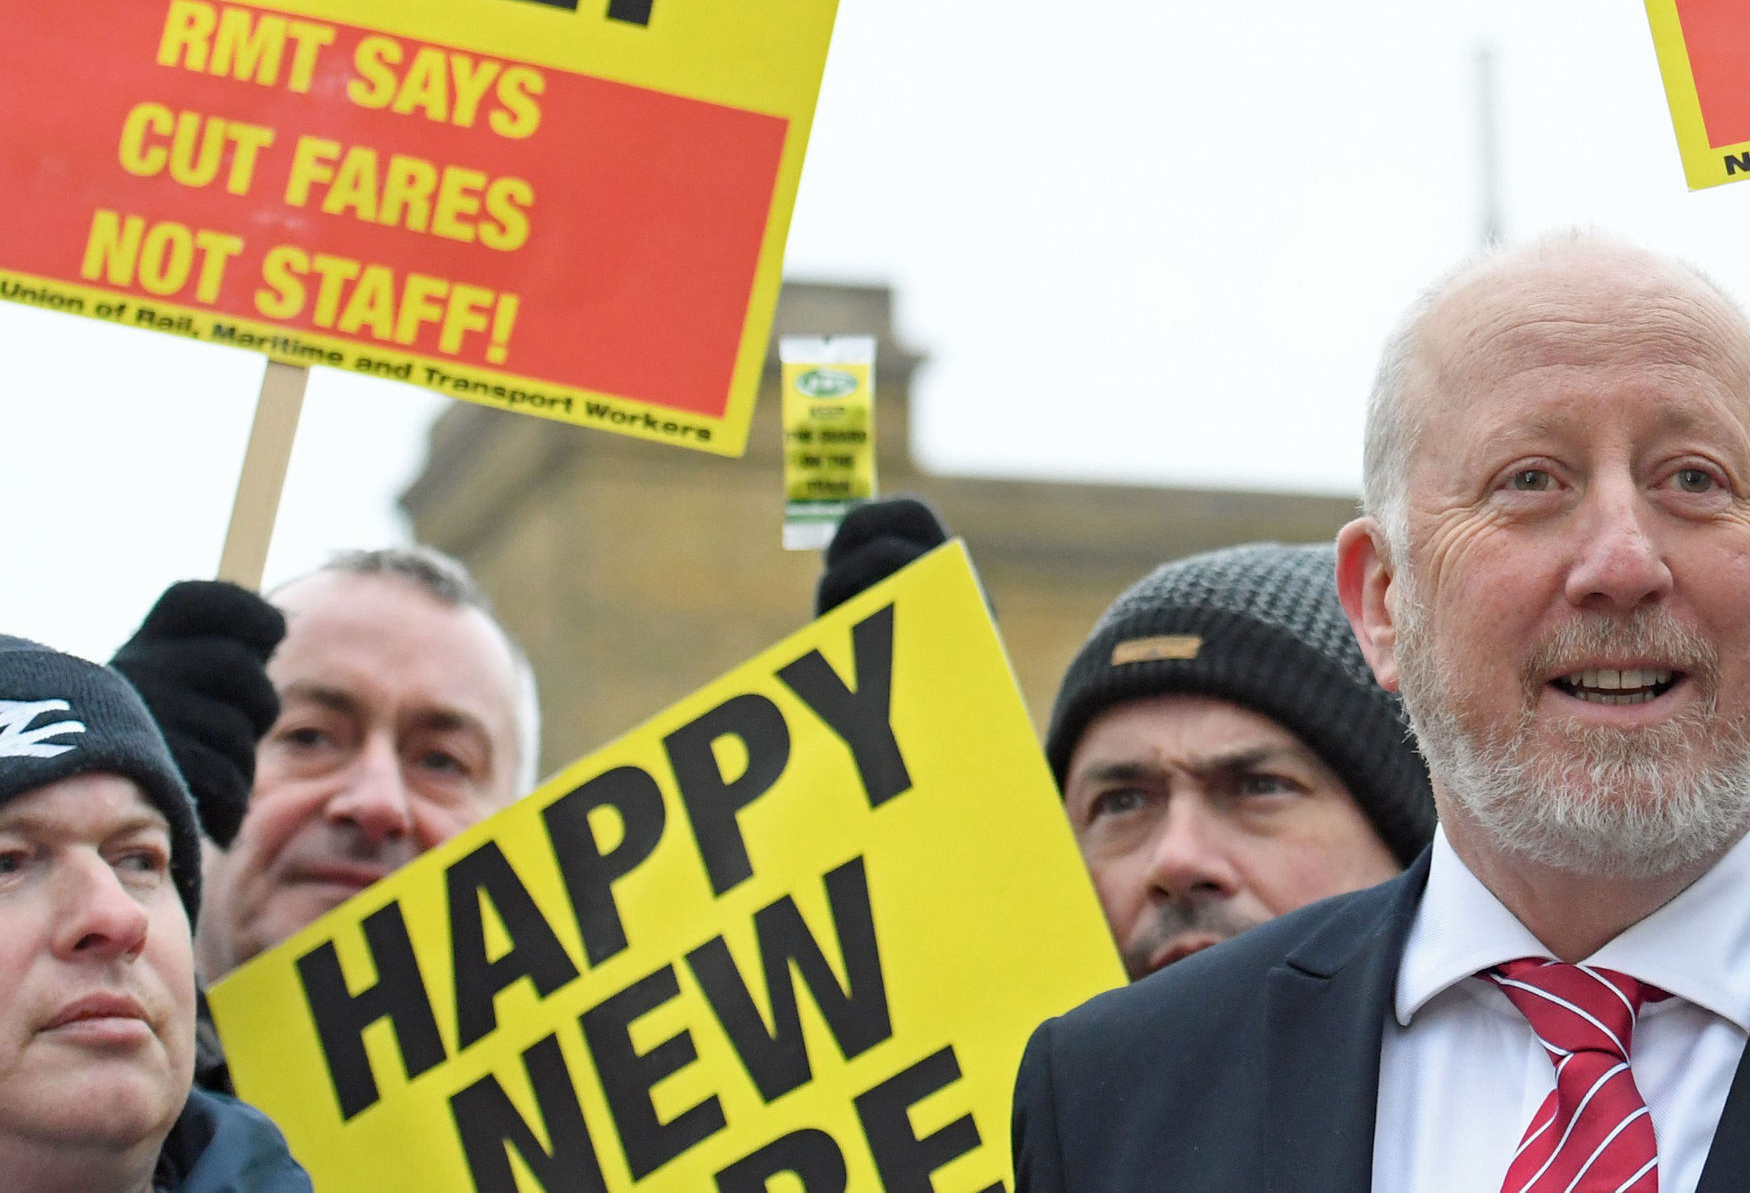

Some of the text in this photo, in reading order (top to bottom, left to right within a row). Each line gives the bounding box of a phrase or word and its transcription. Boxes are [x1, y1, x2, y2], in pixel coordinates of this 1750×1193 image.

[347, 37, 544, 138] SAYS
[120, 103, 533, 250] CUT FARES
[0, 280, 712, 442] Union of Rail, Maritime and Transport Workers
[82, 210, 518, 363] NOT STAFF!
[295, 603, 912, 1122] HAPPY
[449, 855, 892, 1193] NEW
